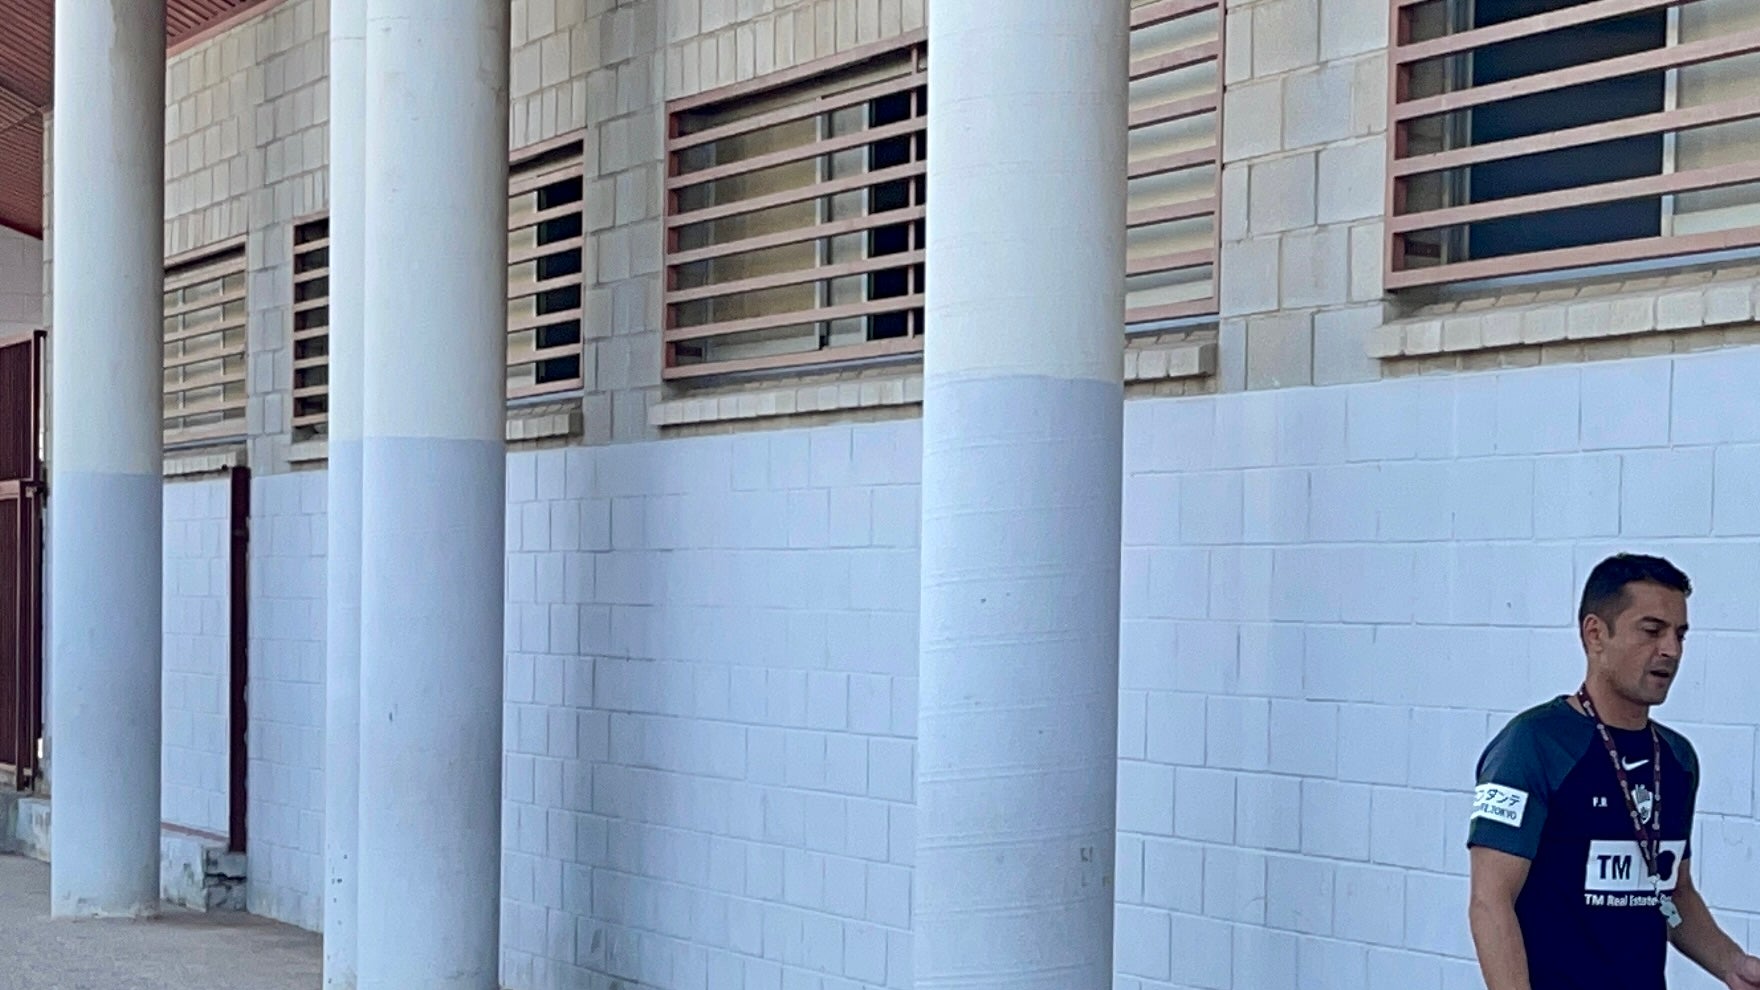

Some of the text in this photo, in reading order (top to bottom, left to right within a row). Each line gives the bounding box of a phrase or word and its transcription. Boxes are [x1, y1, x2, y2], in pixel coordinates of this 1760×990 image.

[1597, 854, 1632, 880] TM
[1584, 893, 1604, 906] TM
[1607, 894, 1628, 906] Real
[1630, 894, 1658, 906] Estate
